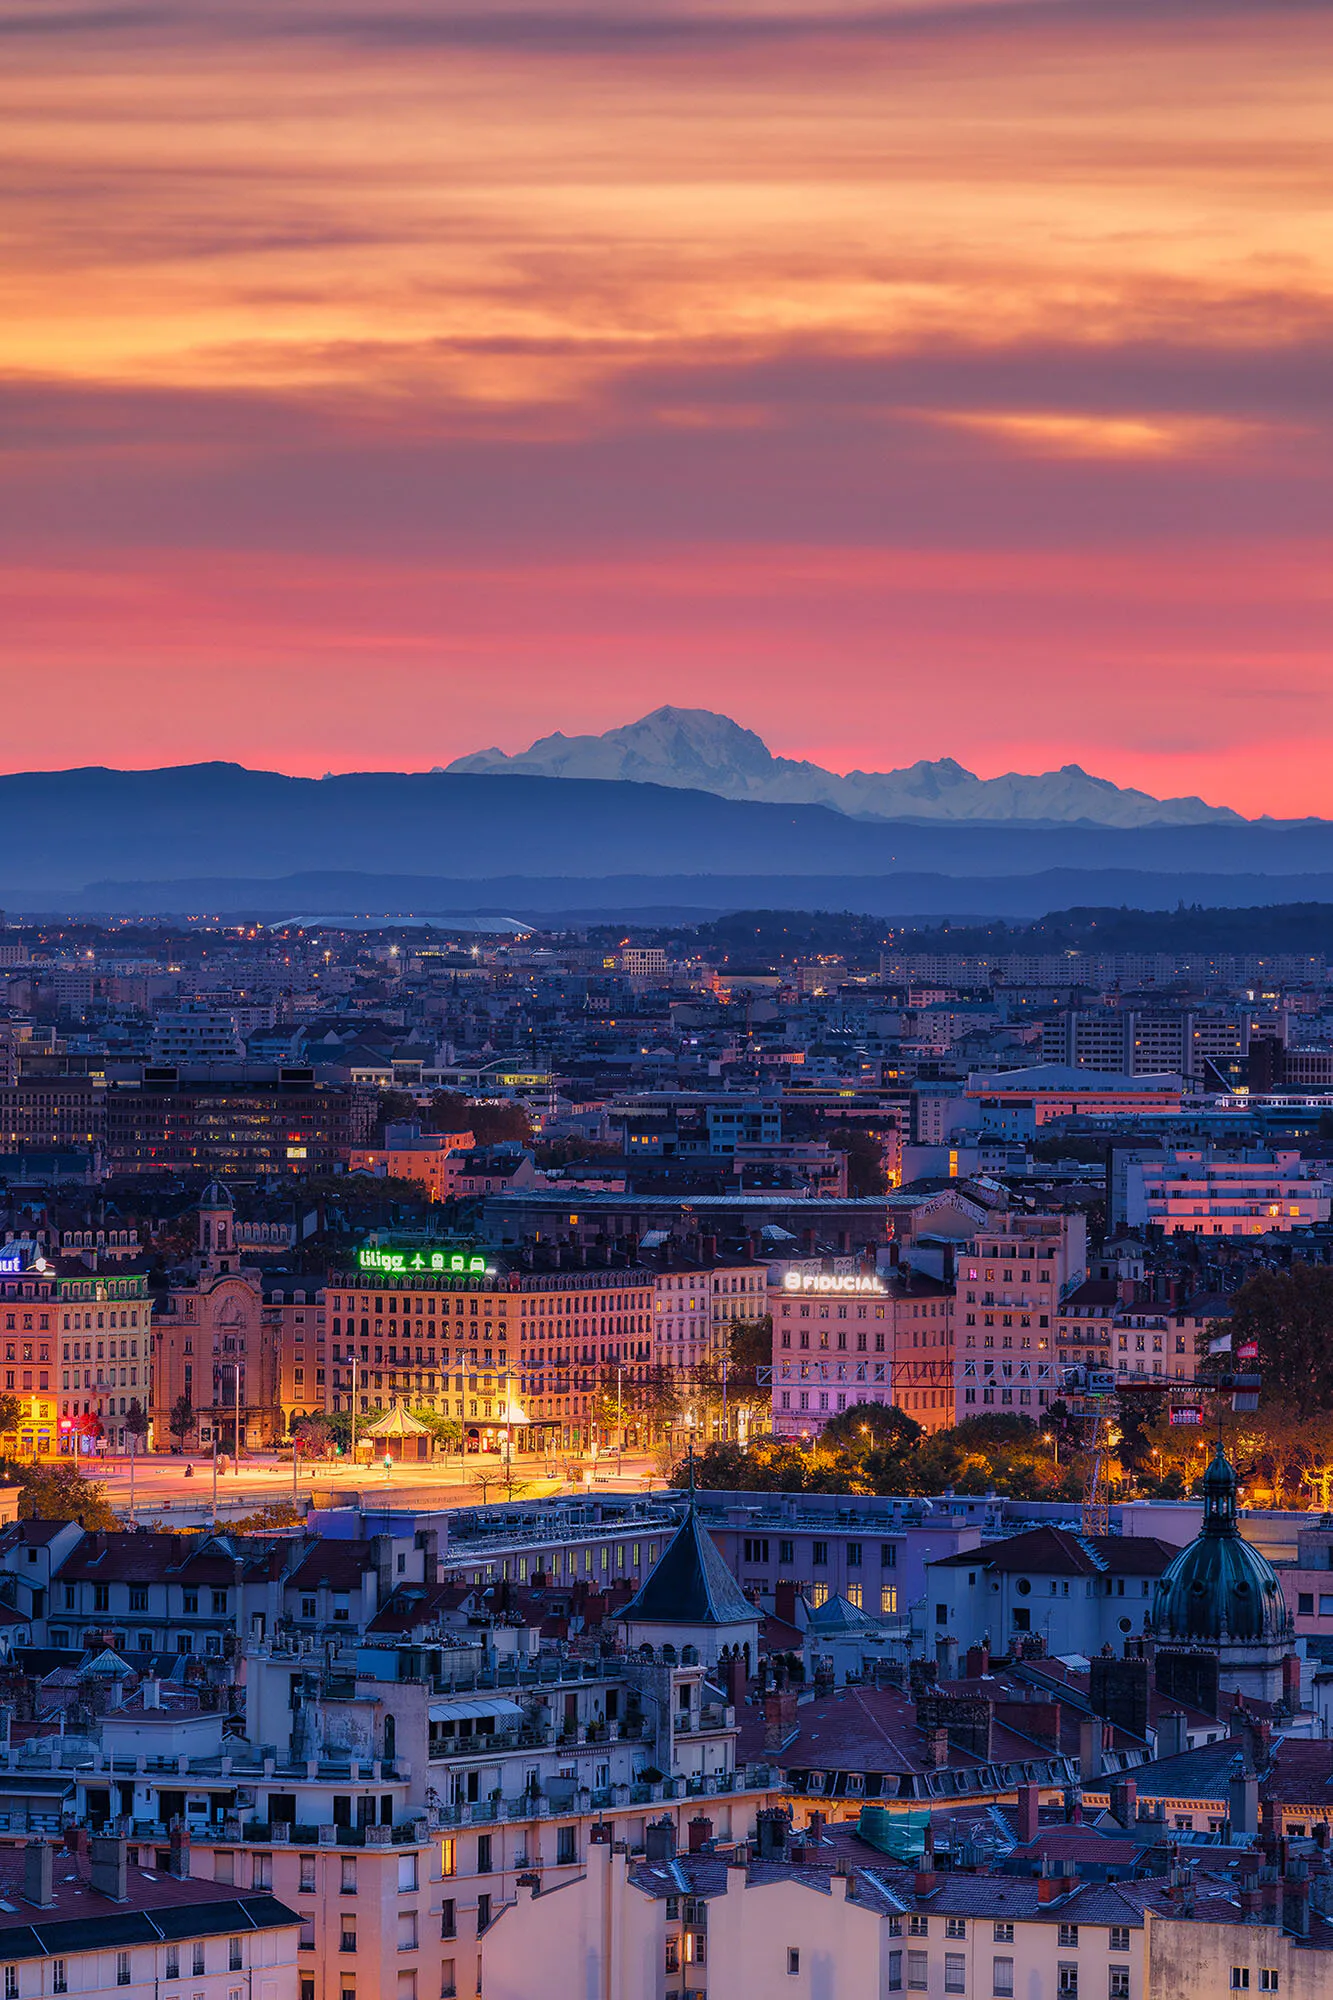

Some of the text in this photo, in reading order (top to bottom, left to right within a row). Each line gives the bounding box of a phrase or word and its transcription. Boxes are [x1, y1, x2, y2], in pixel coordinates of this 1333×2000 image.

[0, 1257, 20, 1271] ut
[360, 1250, 406, 1271] liligo
[803, 1276, 884, 1290] FIDUCIAL
